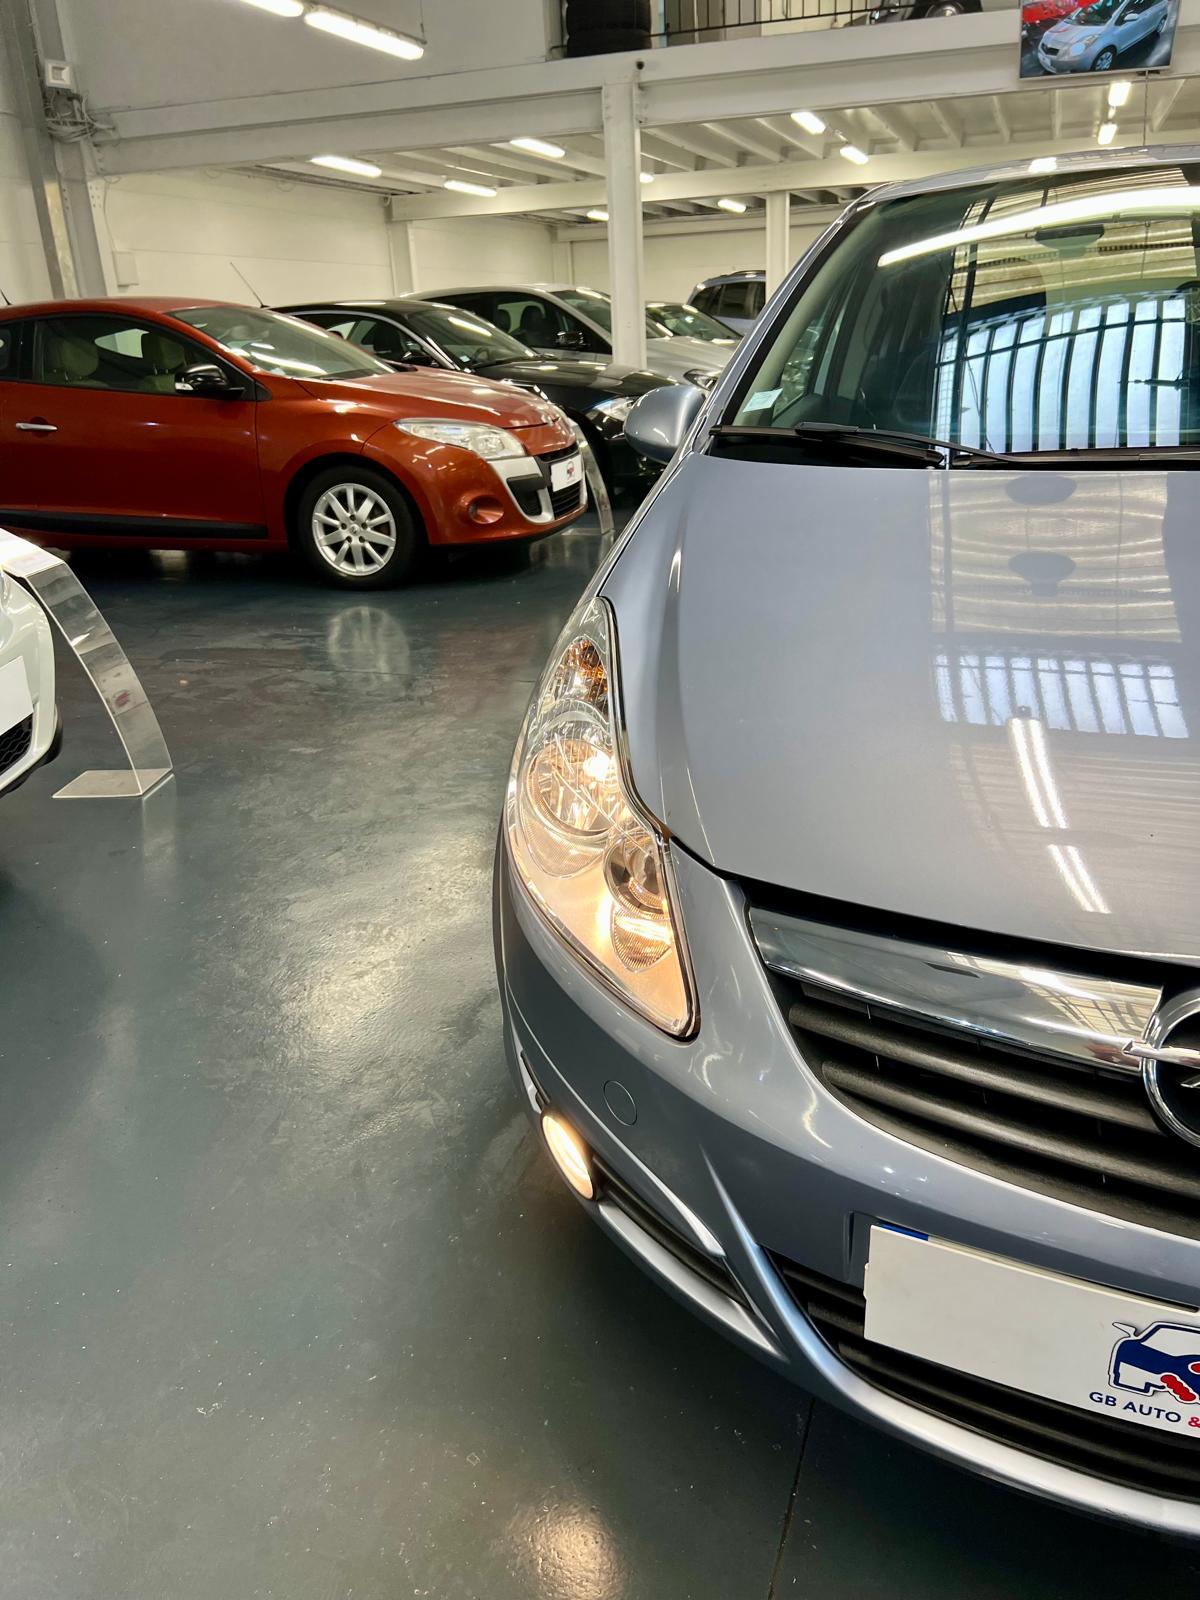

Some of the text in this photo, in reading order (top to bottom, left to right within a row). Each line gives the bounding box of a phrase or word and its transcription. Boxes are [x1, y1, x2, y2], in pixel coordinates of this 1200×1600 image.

[1089, 1392, 1200, 1428] GB AUTO &
